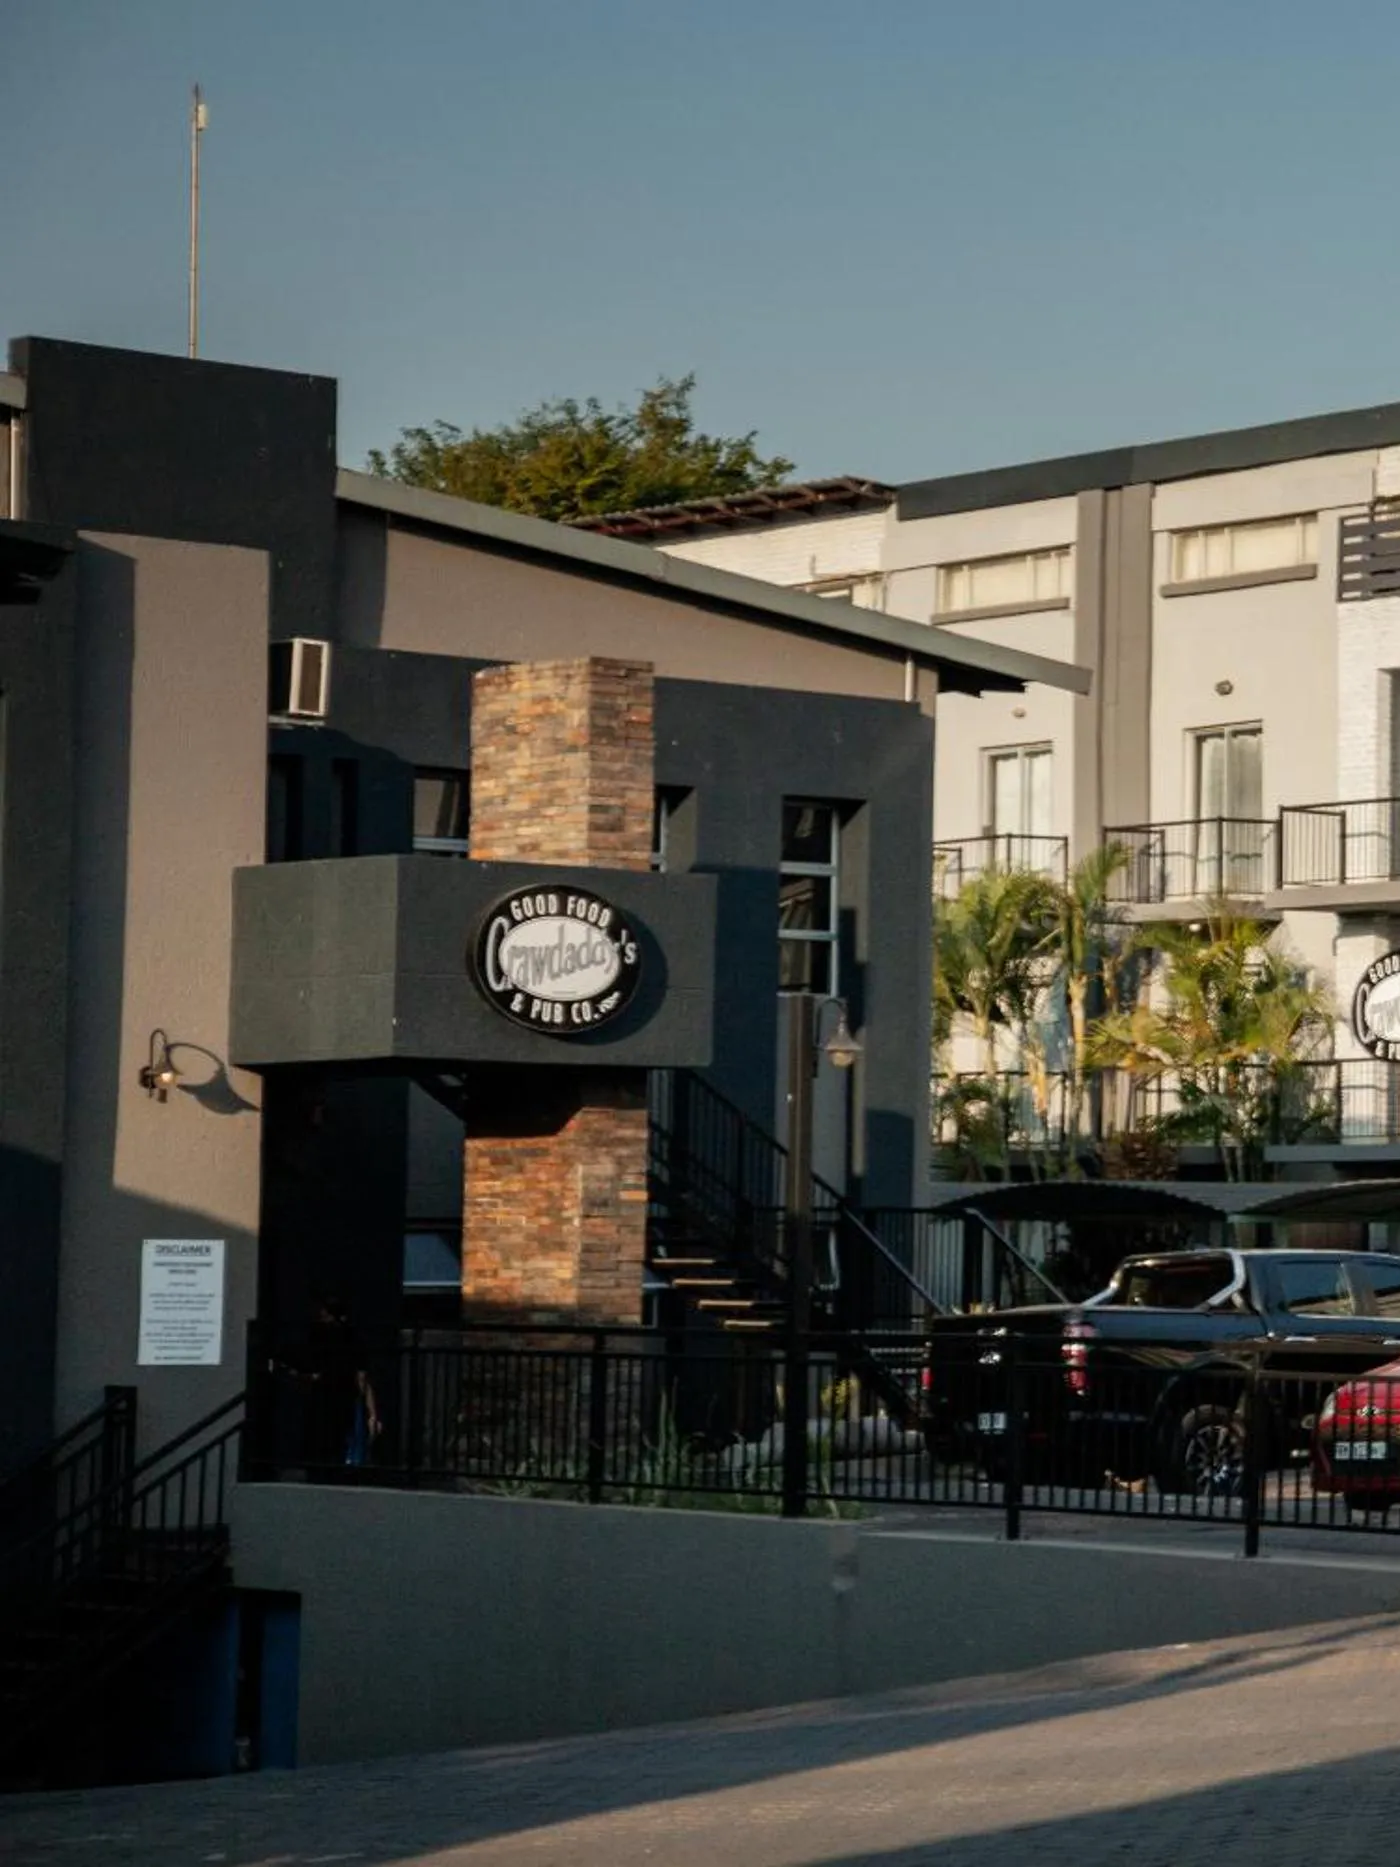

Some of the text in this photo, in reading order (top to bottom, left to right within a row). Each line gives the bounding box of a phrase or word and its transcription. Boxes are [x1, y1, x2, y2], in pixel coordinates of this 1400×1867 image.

[510, 894, 612, 927] GOOD FOOD
[1368, 954, 1400, 983] GOOD
[510, 993, 600, 1024] & PUB CO.
